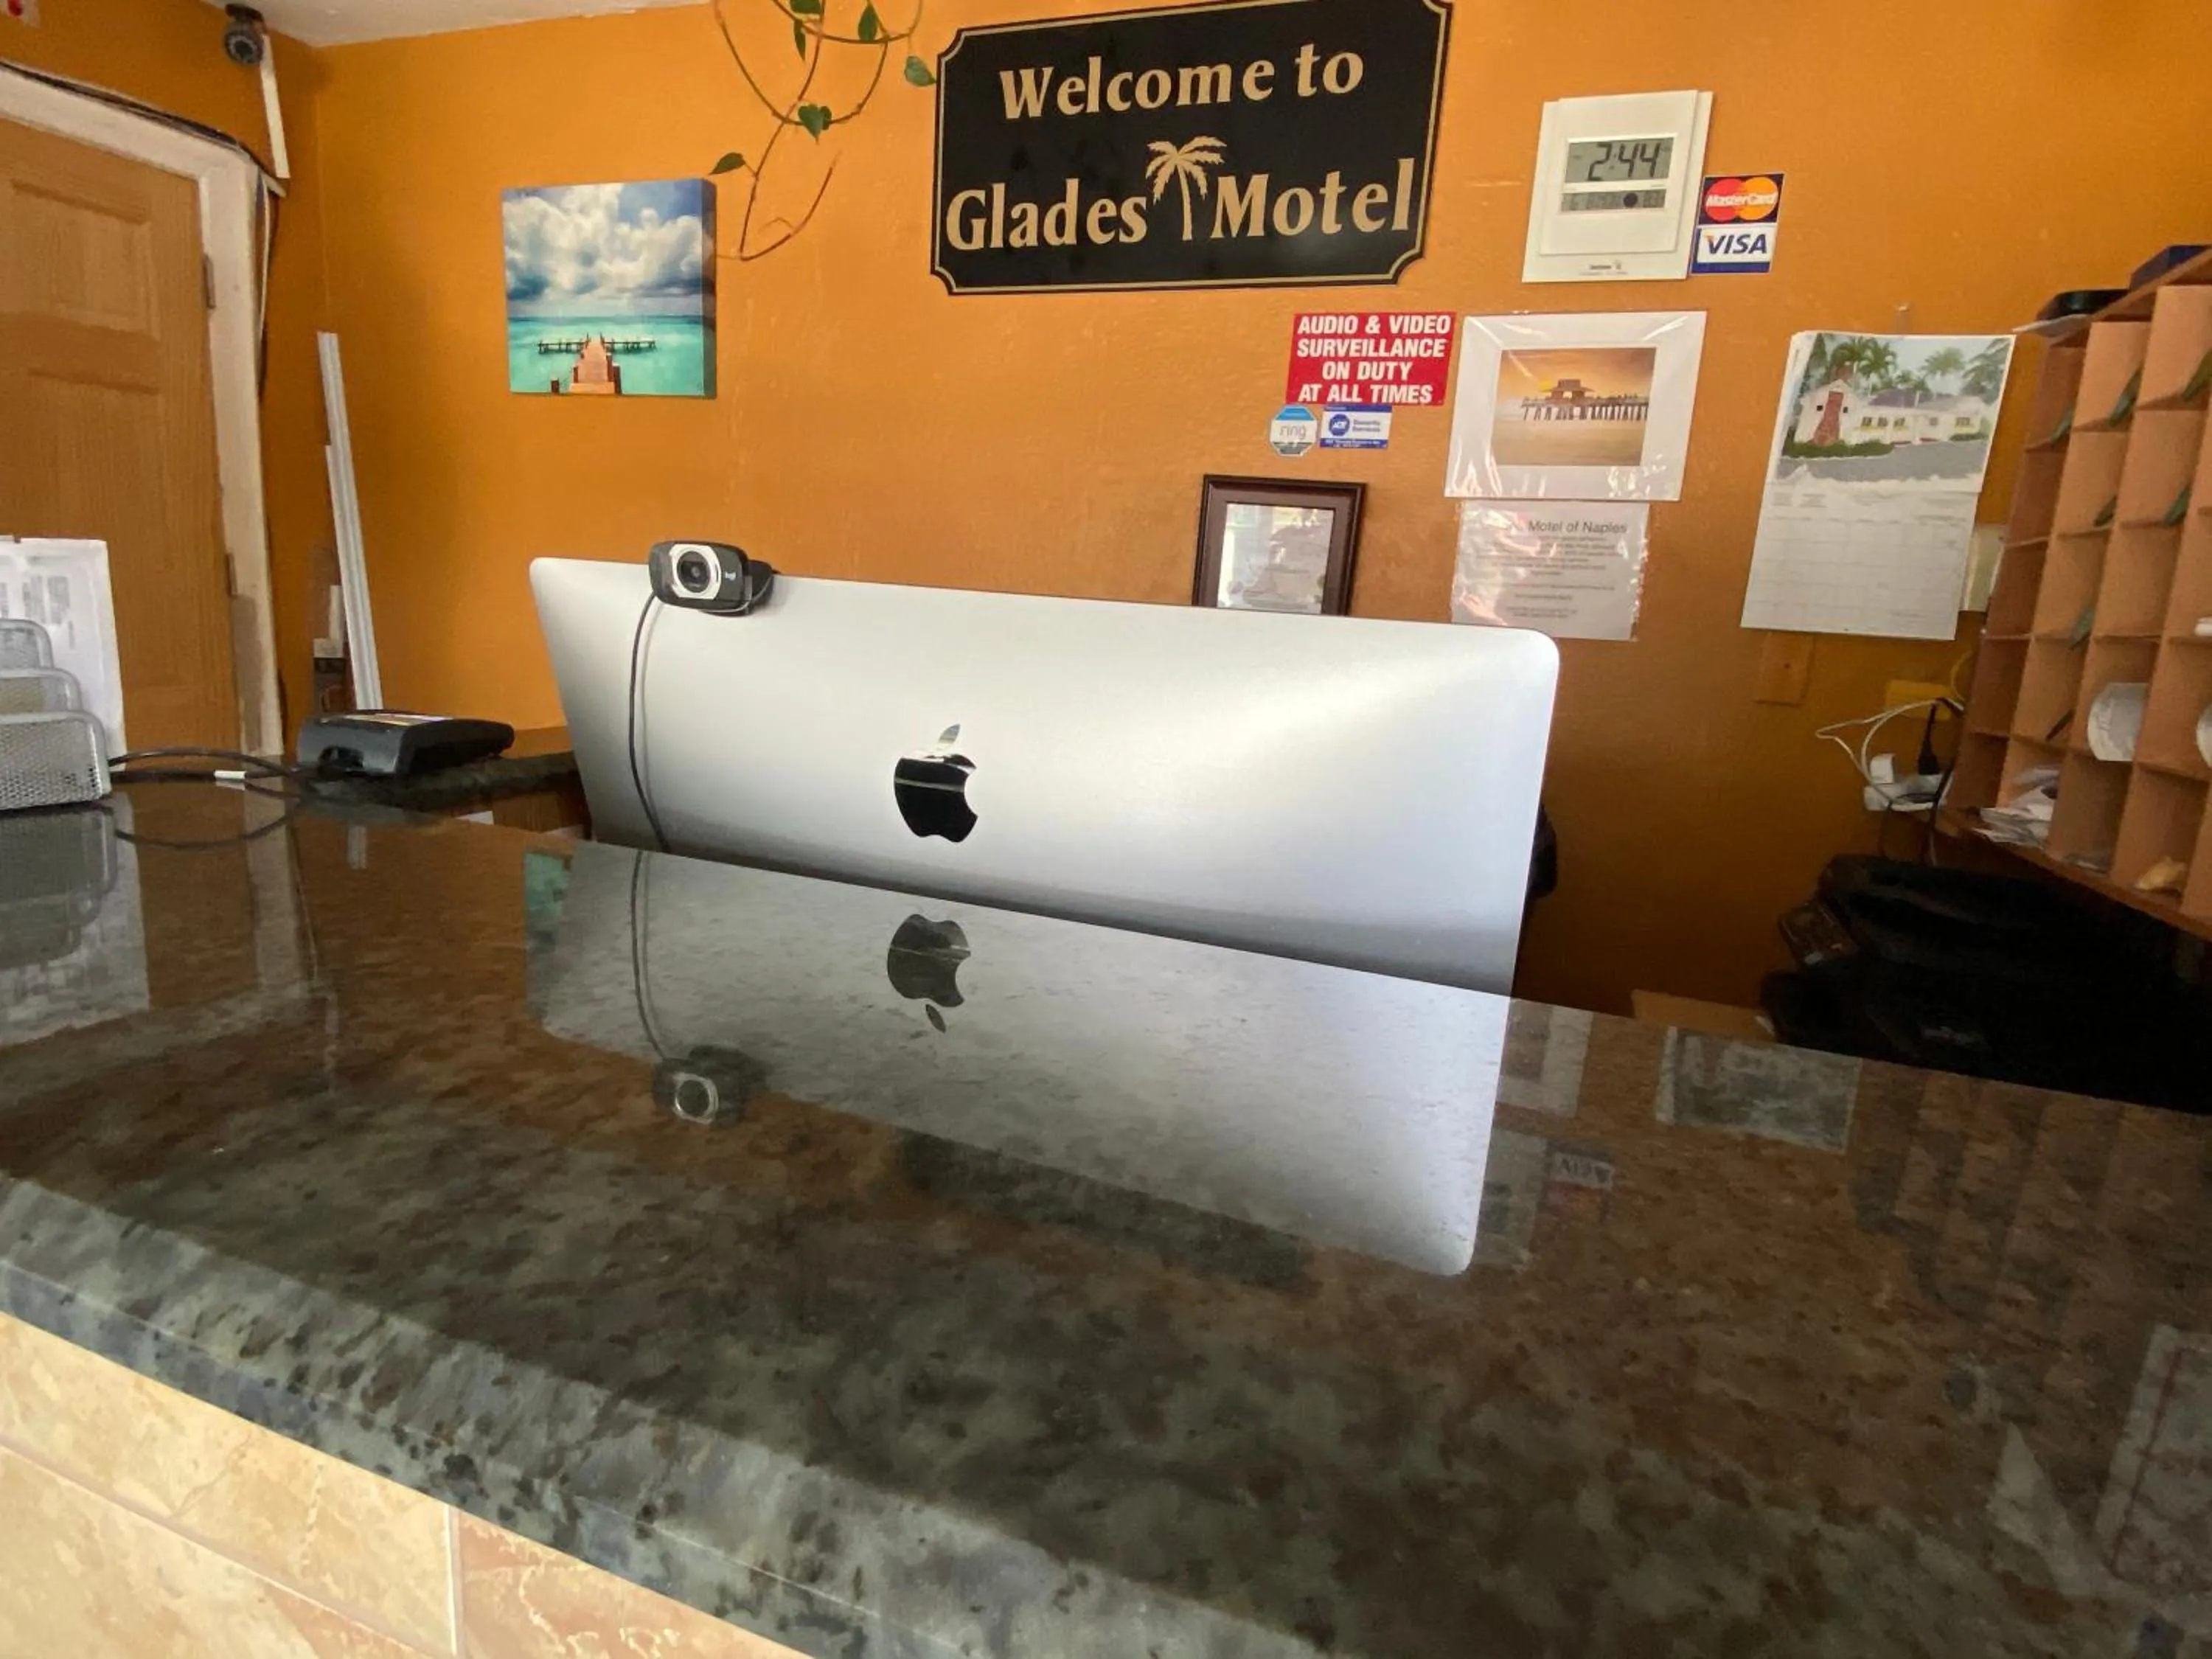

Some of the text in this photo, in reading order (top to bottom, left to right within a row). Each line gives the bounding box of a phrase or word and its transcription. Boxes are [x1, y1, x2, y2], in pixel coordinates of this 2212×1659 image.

[999, 43, 1364, 119] Welcome to
[946, 157, 1415, 250] Glades Motel
[1705, 234, 1767, 254] VISA
[1297, 315, 1451, 335] AUDIO & VIDEO
[1296, 338, 1449, 358] SURVEILLANCE
[1322, 361, 1413, 380] ON DUTY
[1298, 383, 1433, 403] AT ALL TIMES
[1279, 425, 1307, 439] ring
[1528, 520, 1628, 533] Motel of Naples
